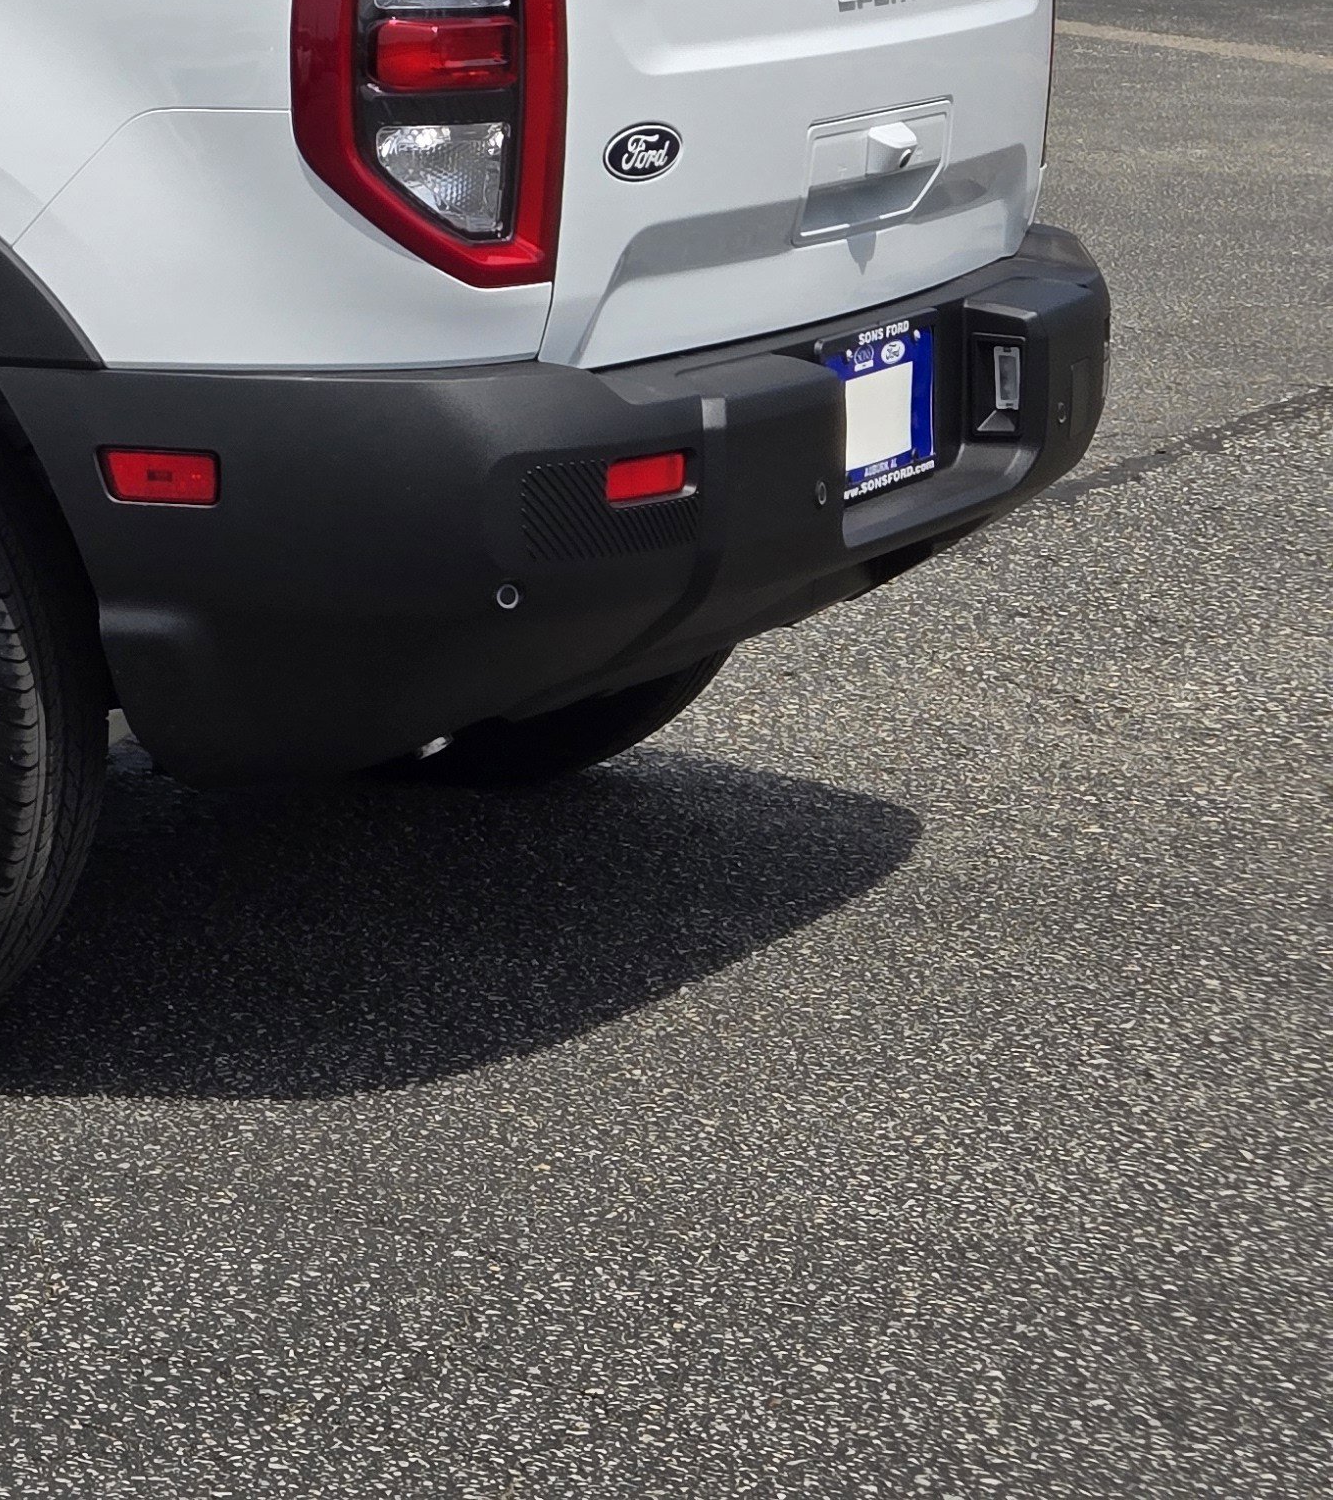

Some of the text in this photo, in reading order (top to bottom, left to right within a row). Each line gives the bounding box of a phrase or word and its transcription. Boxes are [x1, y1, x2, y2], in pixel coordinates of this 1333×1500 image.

[621, 134, 670, 170] Ford
[858, 320, 909, 345] SONS FORD
